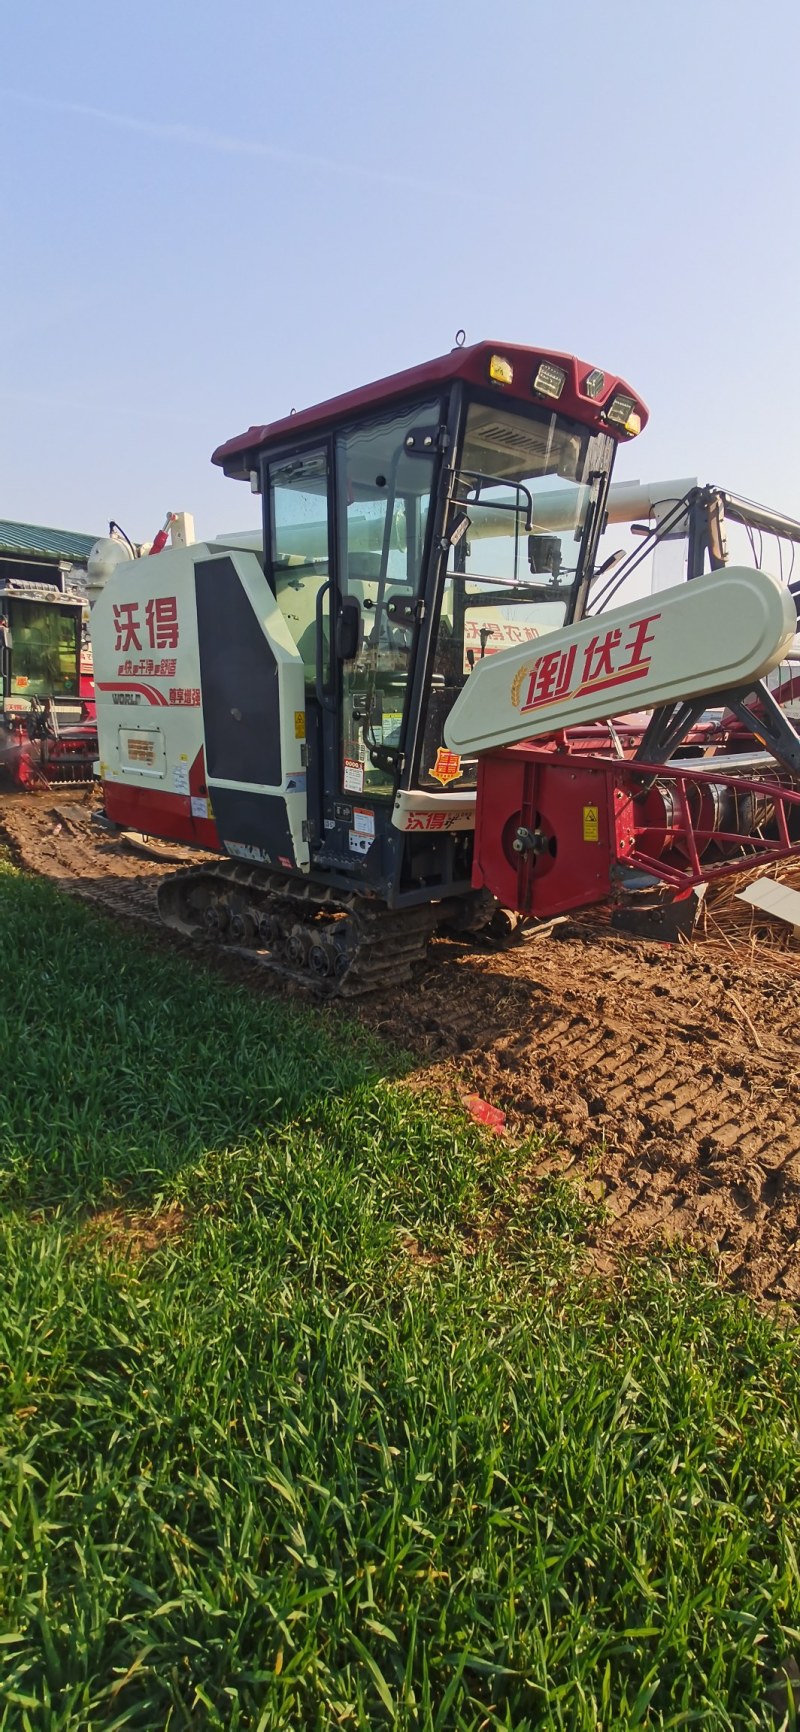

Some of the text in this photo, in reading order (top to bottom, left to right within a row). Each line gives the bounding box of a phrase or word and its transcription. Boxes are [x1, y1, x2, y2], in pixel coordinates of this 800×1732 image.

[112, 596, 179, 652] 沃得
[526, 613, 662, 706] 倒伏王
[112, 693, 142, 706] WORLD
